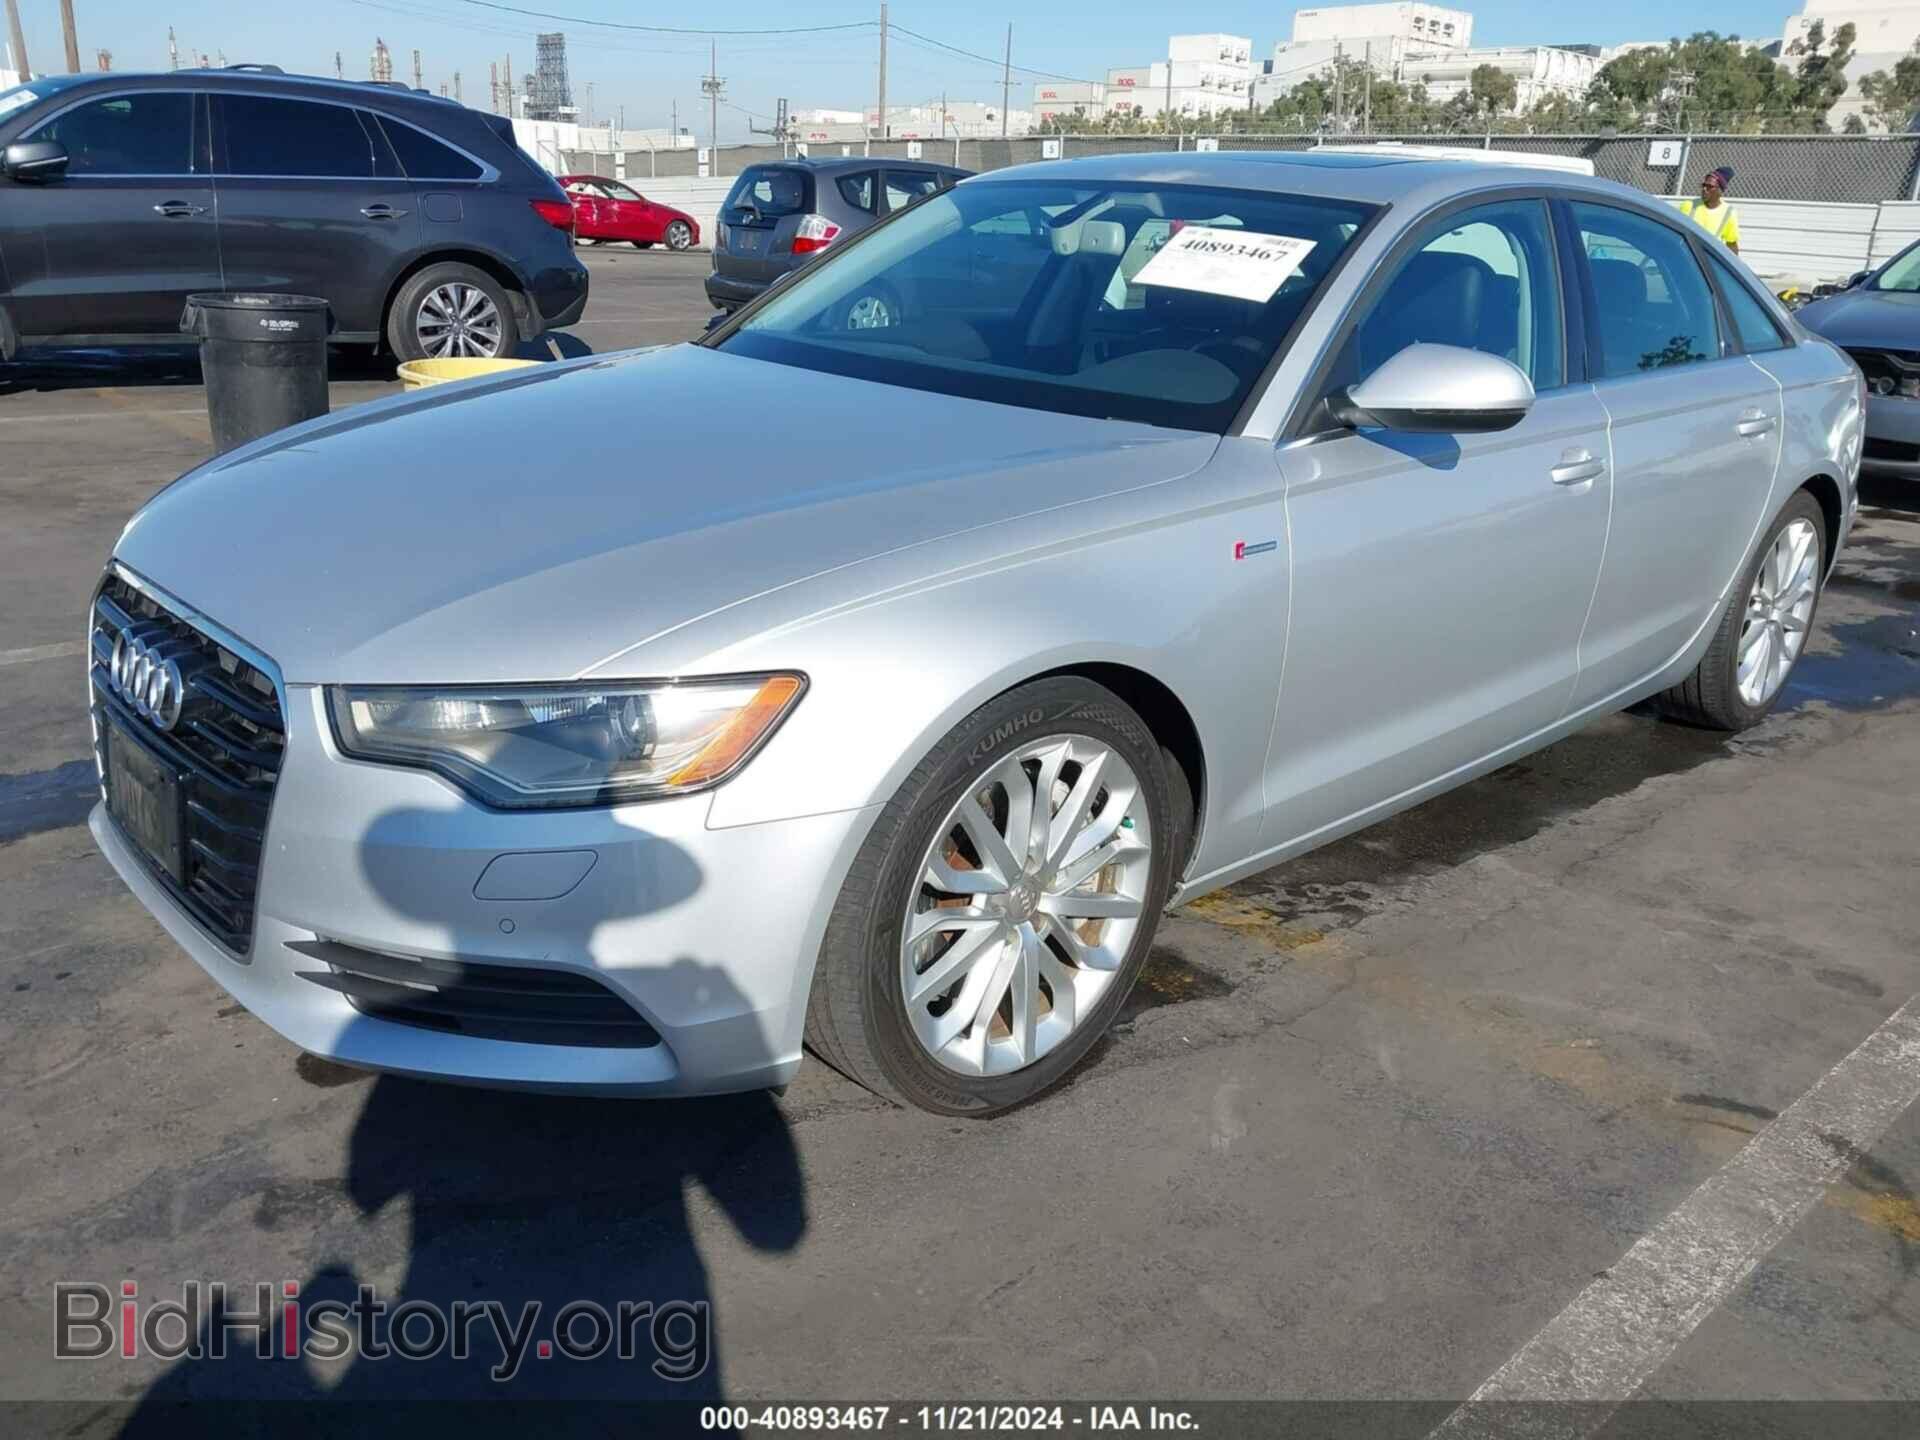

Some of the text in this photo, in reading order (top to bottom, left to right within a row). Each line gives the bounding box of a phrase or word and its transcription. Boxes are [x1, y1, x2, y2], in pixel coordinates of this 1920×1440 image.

[1662, 147, 1671, 160] 8
[1180, 239, 1288, 261] 40893467
[968, 708, 1044, 766] KUMHO
